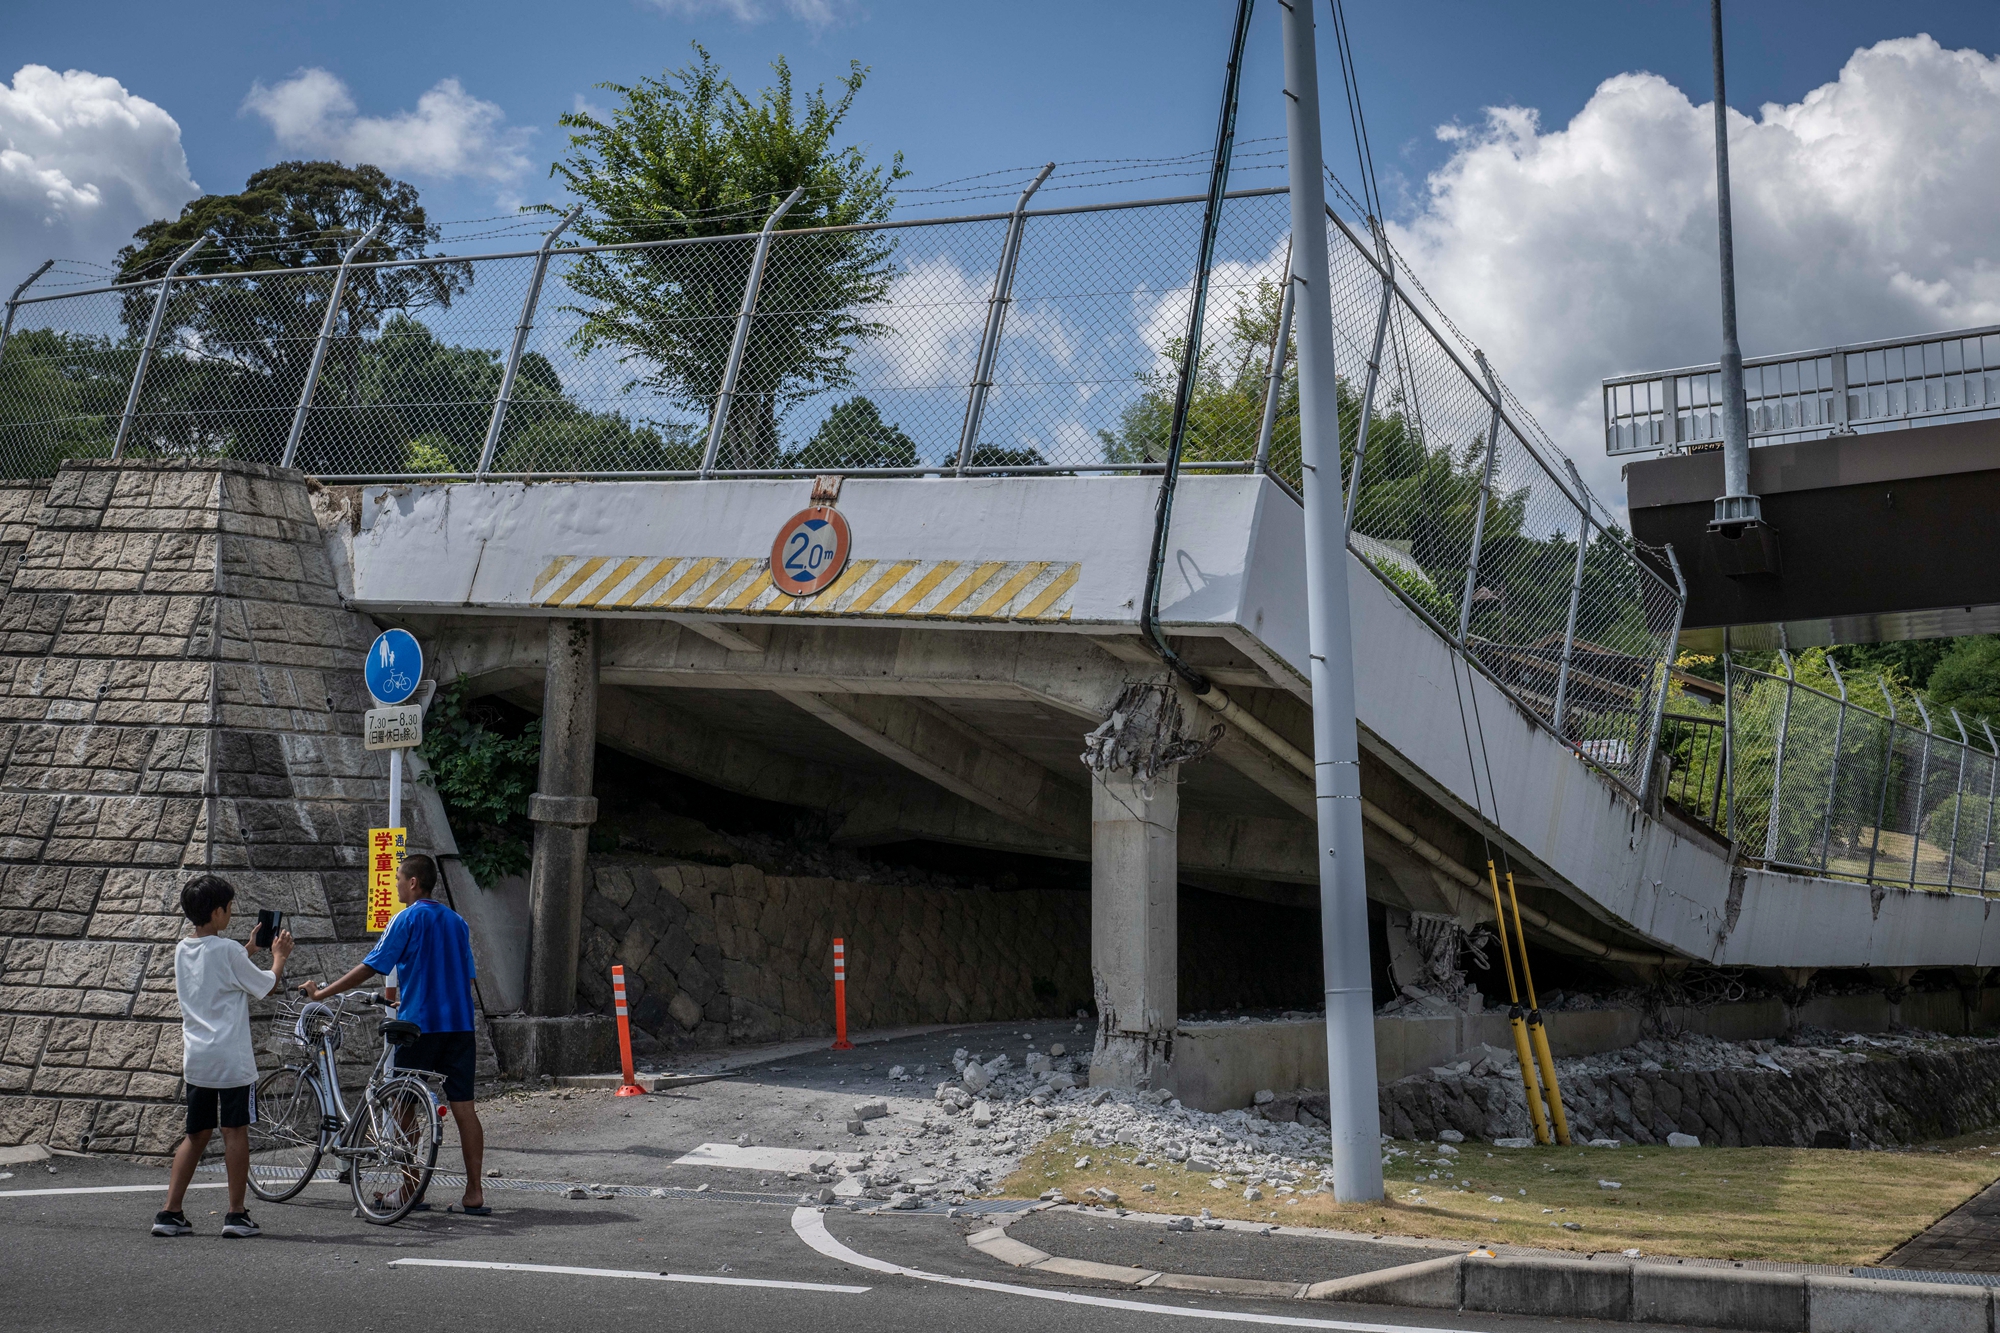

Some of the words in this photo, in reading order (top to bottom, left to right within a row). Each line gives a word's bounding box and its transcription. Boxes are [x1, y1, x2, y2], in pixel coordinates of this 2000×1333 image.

[373, 832, 393, 928] 学童に注意
